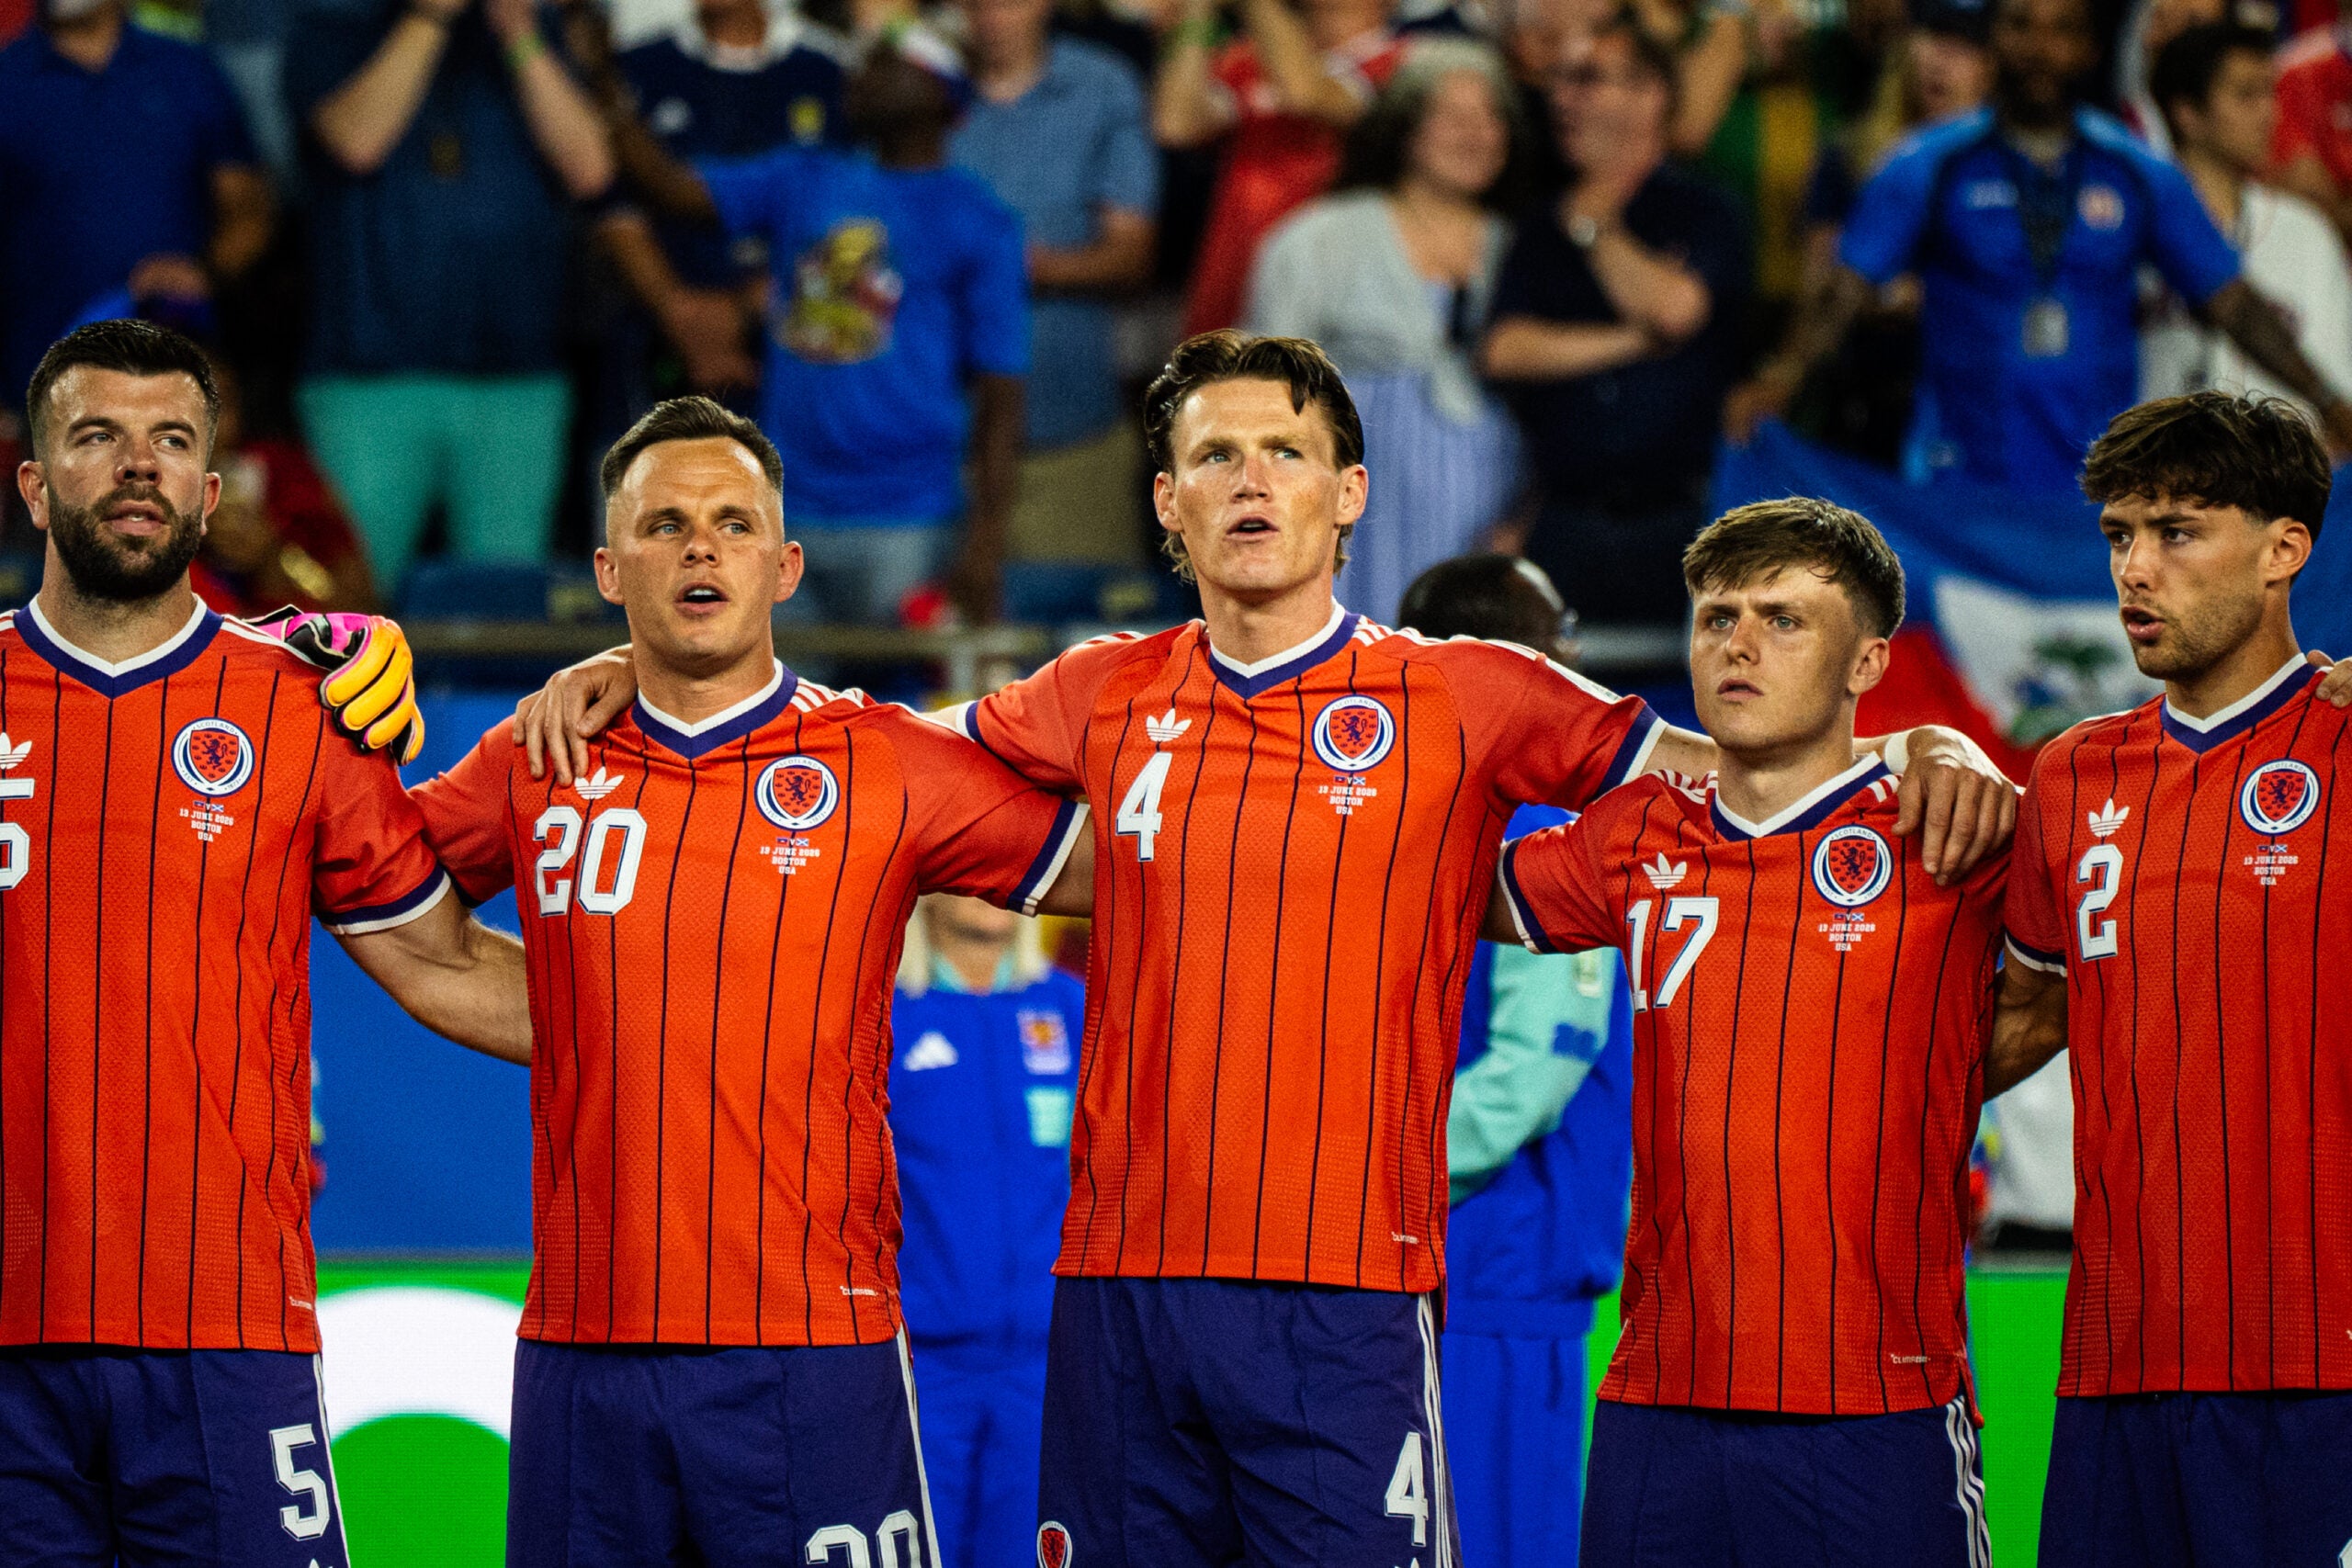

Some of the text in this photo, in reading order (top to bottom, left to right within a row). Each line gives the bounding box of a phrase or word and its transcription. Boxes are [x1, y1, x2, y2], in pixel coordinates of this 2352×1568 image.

[196, 721, 235, 734] SCOTLAND
[779, 759, 819, 769] SCOTLAND
[1115, 751, 1173, 862] 4
[191, 810, 213, 820] JUNE
[190, 819, 222, 834] BOSTON
[198, 831, 213, 842] USA
[1834, 829, 1873, 839] SCOTLAND
[533, 806, 648, 918] 20
[2076, 844, 2124, 963] 2
[1829, 923, 1852, 932] JUNE
[1828, 933, 1861, 942] BOSTON
[1835, 943, 1851, 952] USA
[1626, 897, 1719, 1013] 17
[269, 1424, 330, 1541] 5
[1385, 1432, 1429, 1547] 4
